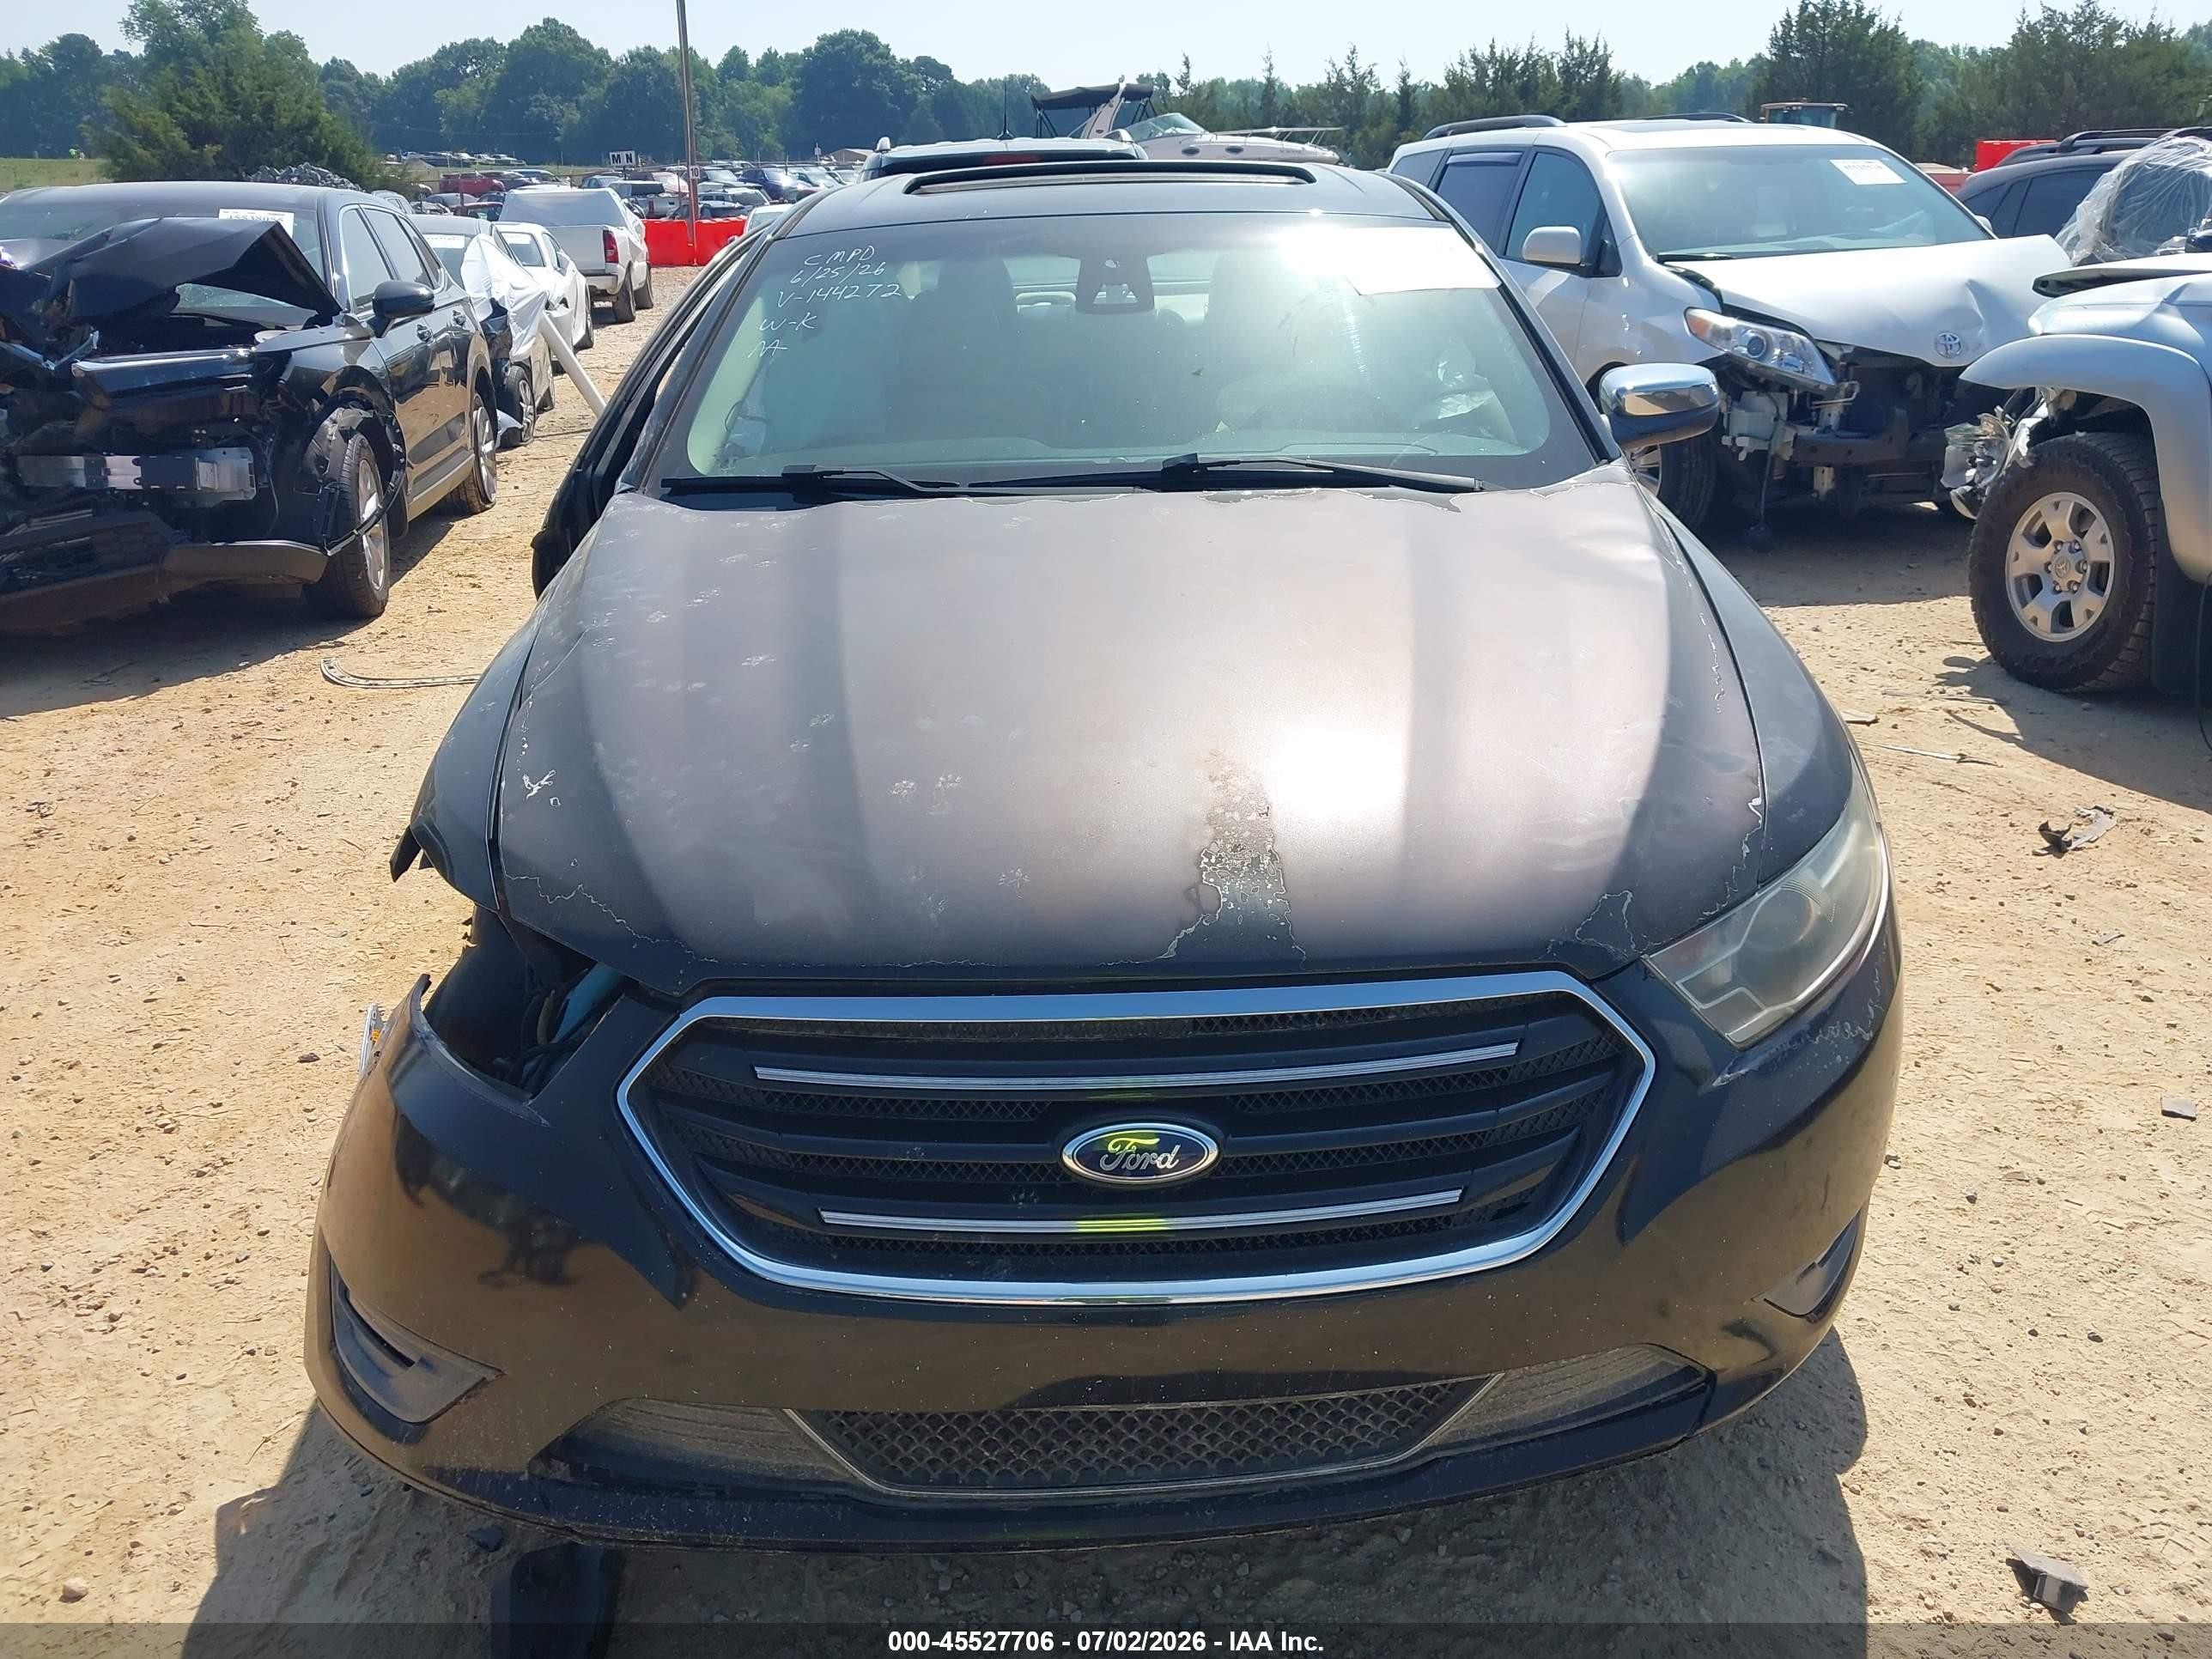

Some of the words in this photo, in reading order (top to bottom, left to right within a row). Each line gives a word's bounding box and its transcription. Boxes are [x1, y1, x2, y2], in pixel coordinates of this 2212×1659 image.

[611, 155, 622, 164] M
[625, 153, 633, 164] N
[690, 167, 699, 178] 10
[789, 261, 886, 288] 6/25/26
[777, 283, 902, 308] V-144272
[1099, 1137, 1182, 1171] Ford
